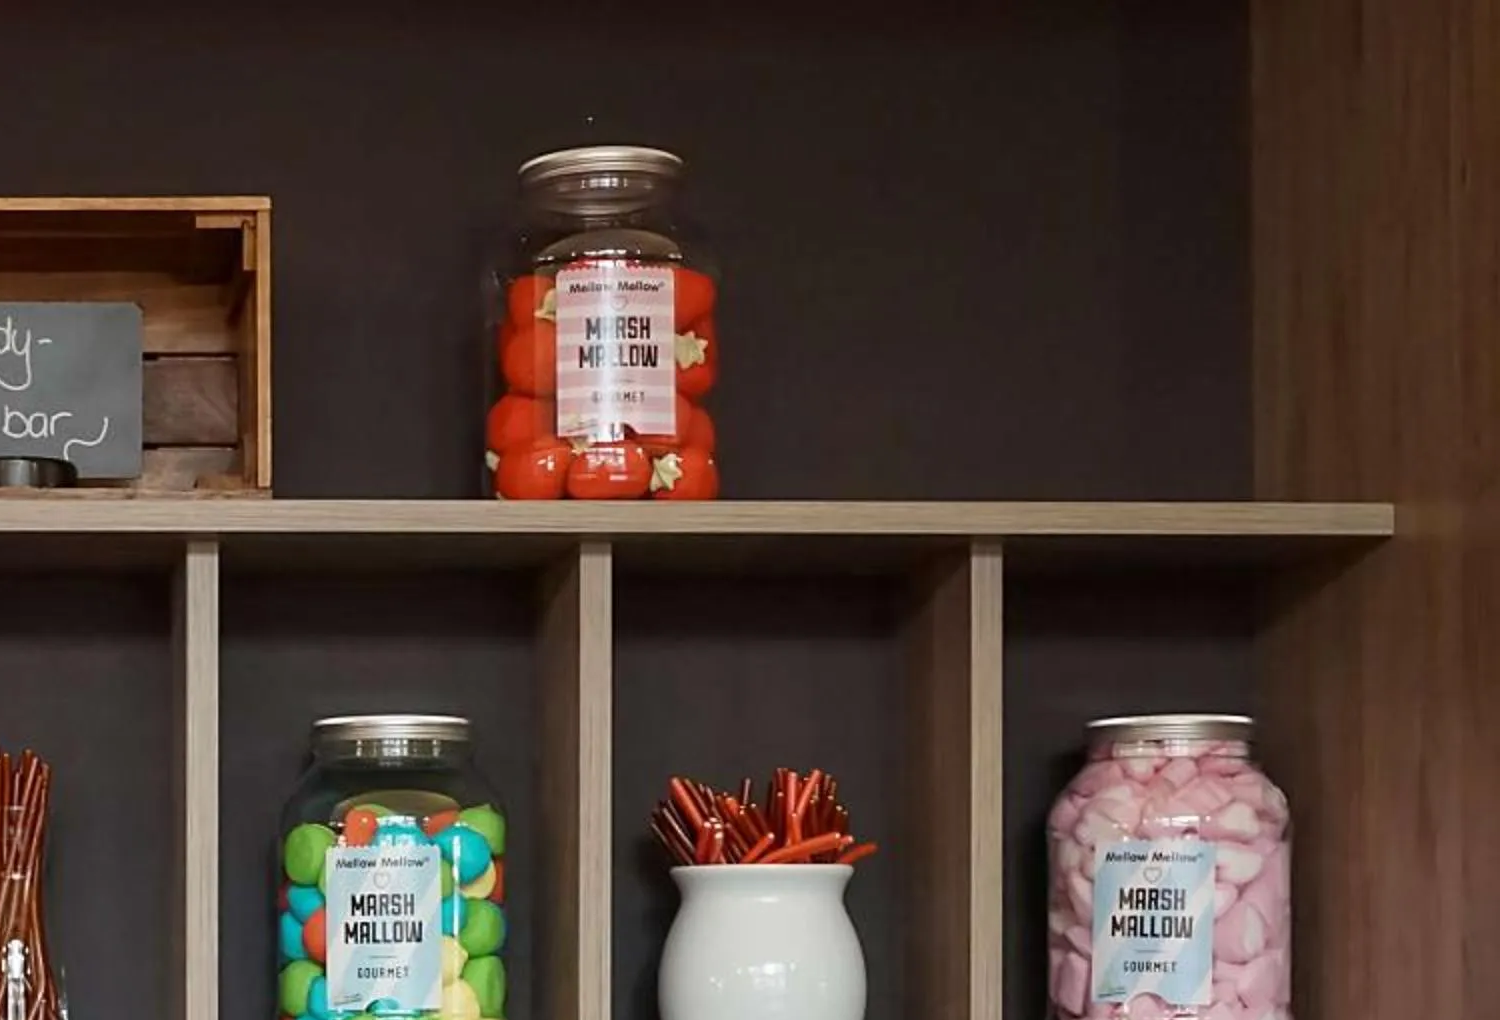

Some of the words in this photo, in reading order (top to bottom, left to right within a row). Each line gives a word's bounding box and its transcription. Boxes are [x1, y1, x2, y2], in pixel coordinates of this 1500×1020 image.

[591, 390, 645, 403] GRMET
[3, 404, 74, 438] bar
[335, 857, 377, 869] Mellow
[381, 856, 425, 868] Mellow
[1105, 850, 1148, 863] Mellow
[351, 894, 415, 917] MARSH
[1118, 887, 1187, 911] MARSH
[344, 921, 423, 945] MALLOW
[1111, 914, 1194, 939] MALLOW
[357, 965, 410, 979] GOURMET
[1123, 960, 1178, 973] GOURMET
